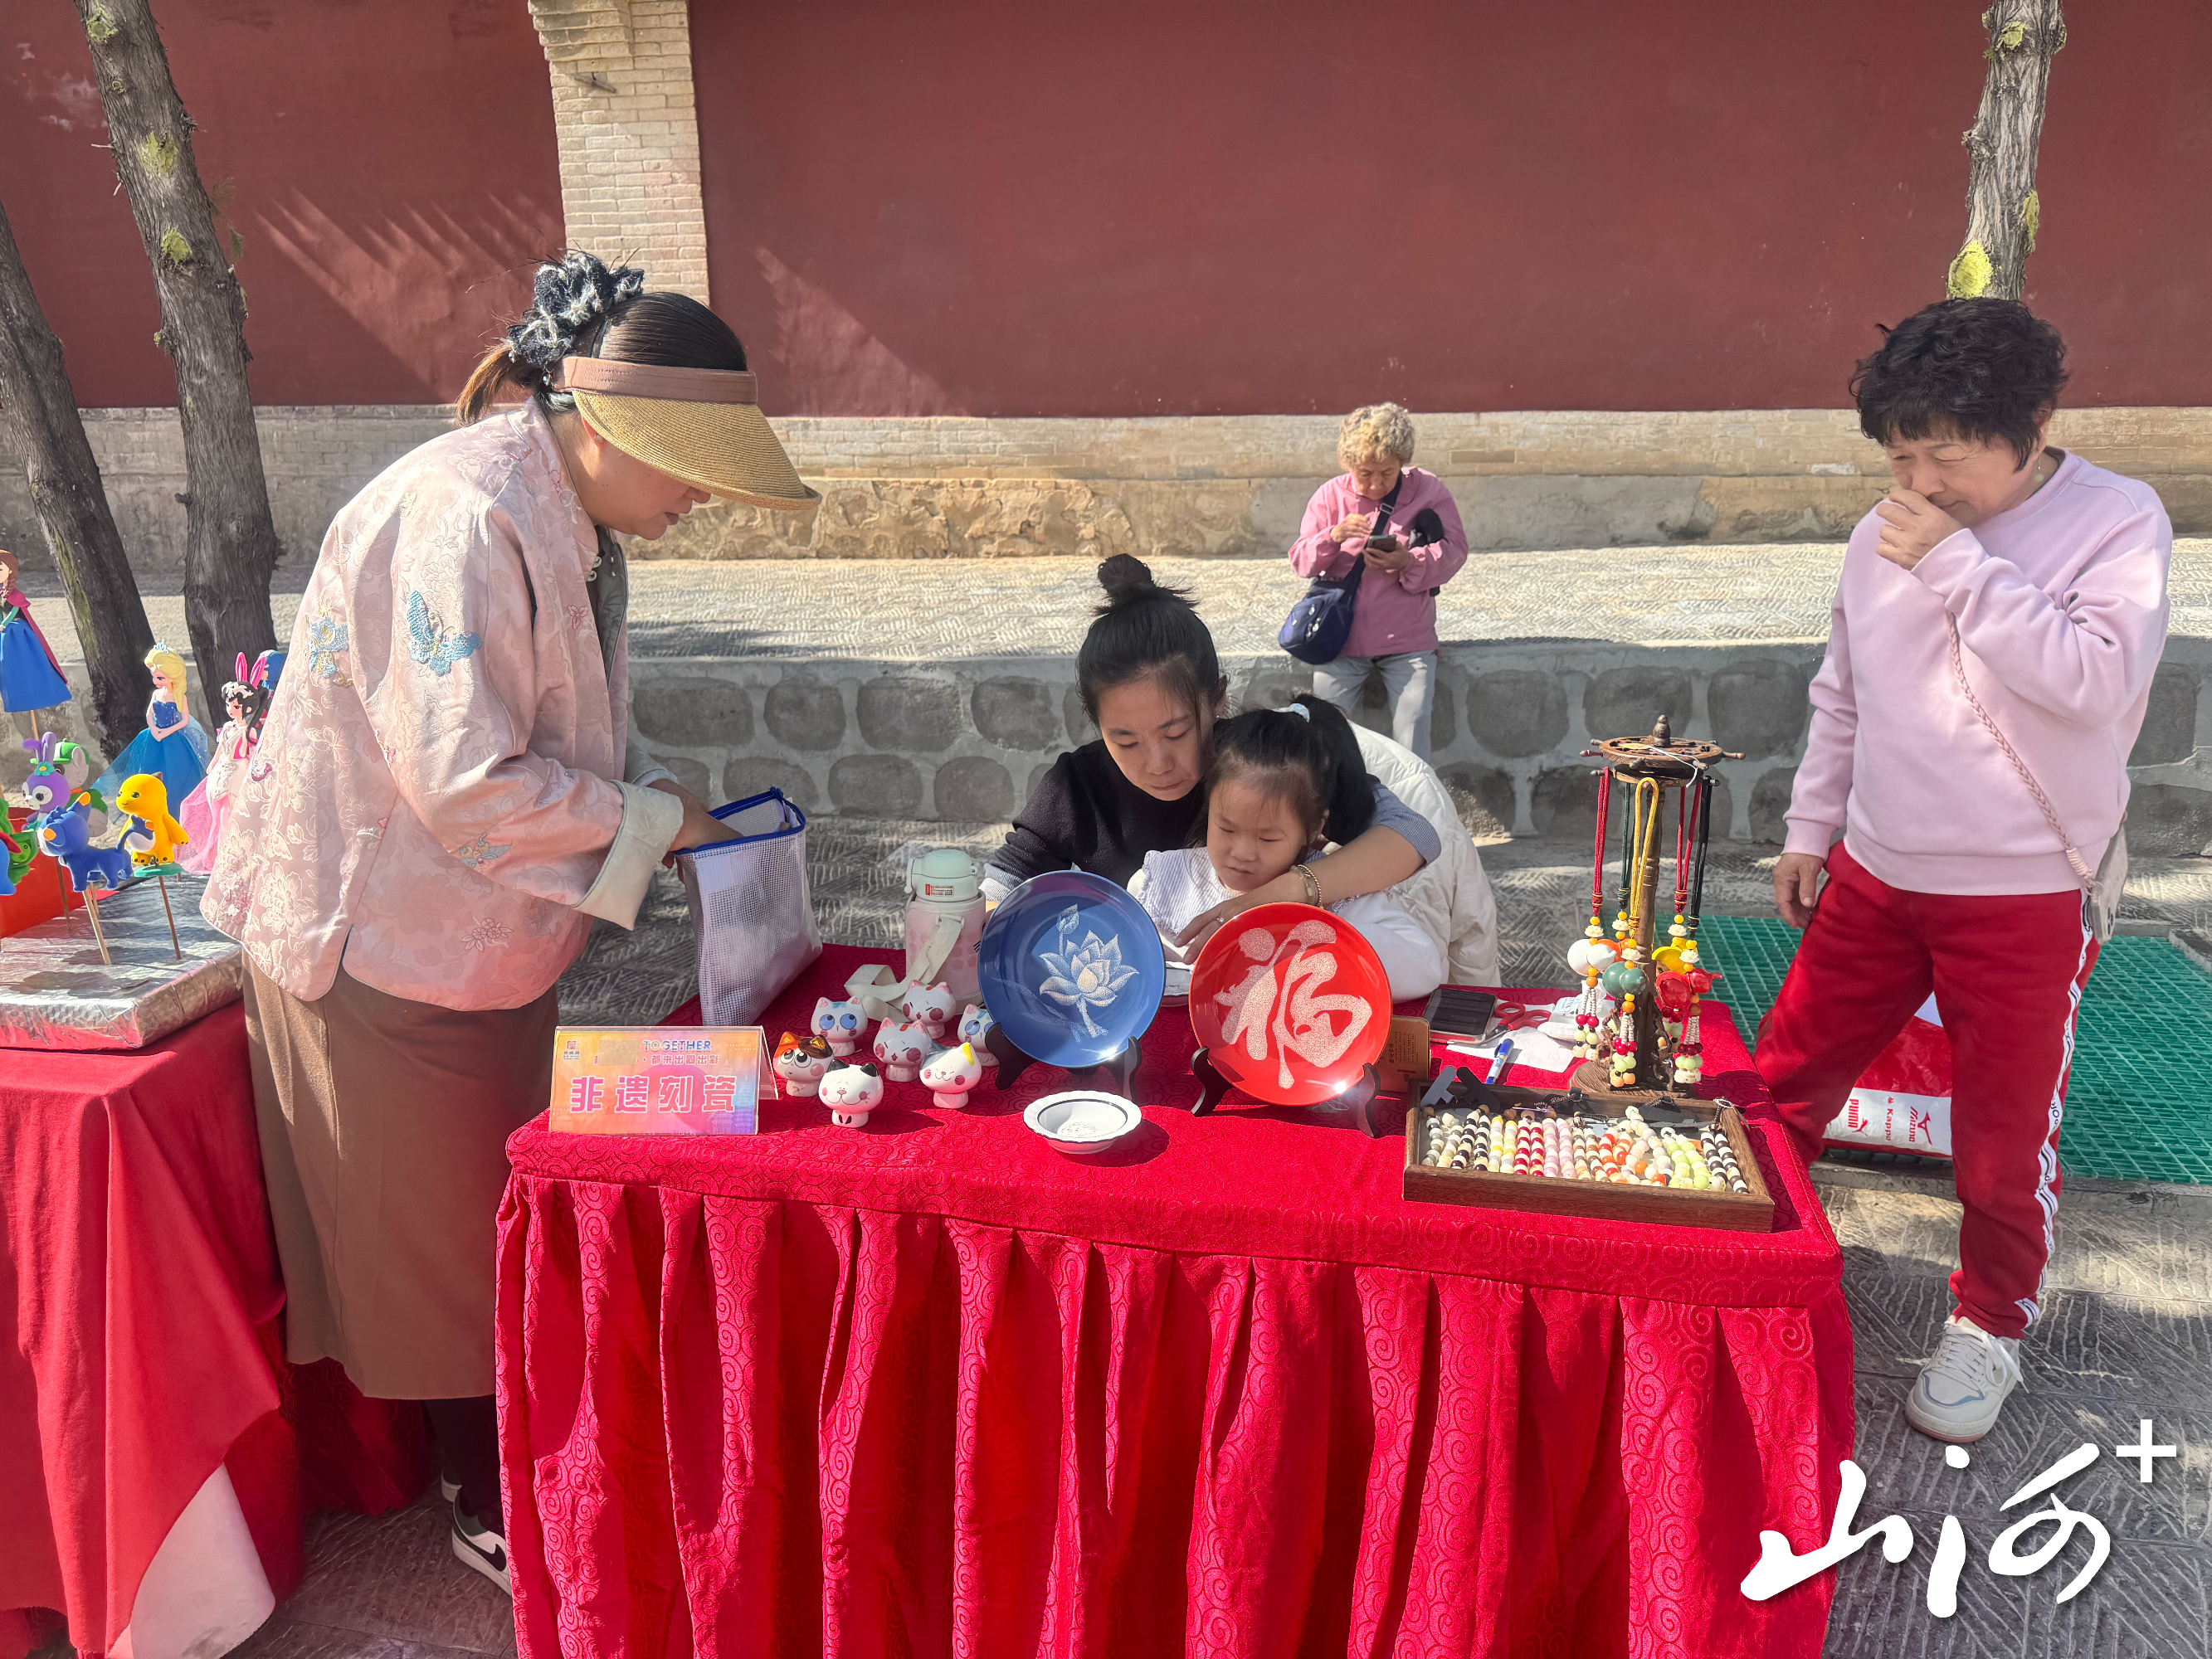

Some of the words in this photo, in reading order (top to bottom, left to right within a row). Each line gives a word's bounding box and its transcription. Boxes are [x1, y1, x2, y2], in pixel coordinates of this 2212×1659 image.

[643, 1039, 712, 1052] TOGETHER
[570, 1075, 737, 1113] 非遗刻瓷
[1848, 1099, 1859, 1128] PUMA
